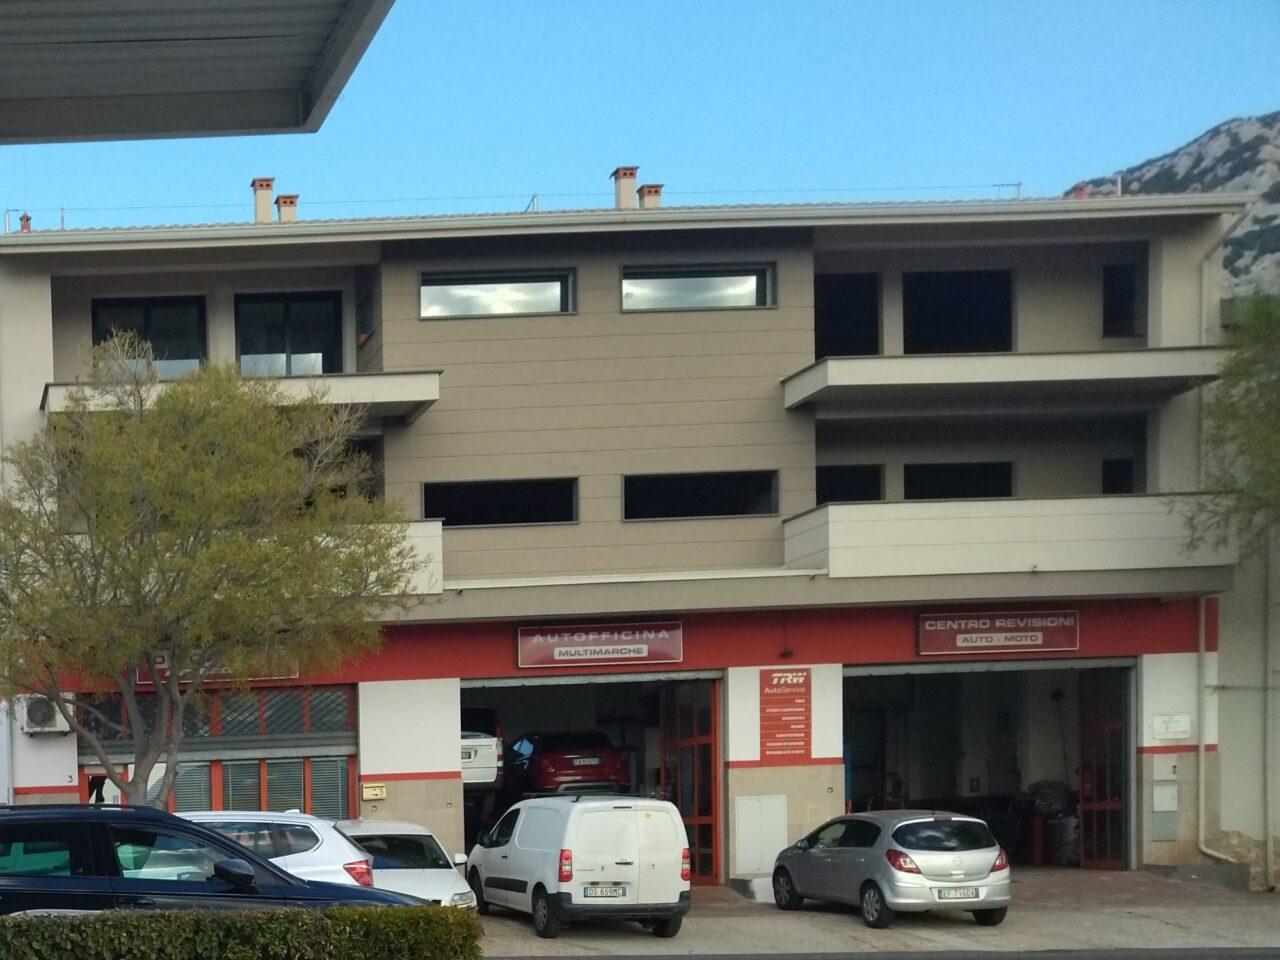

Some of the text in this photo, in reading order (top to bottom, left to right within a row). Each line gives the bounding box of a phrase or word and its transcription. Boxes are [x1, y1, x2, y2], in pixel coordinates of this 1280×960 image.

[924, 616, 1075, 631] CENTRO REVISIONI
[531, 629, 670, 644] AUTOFFICINA
[961, 636, 994, 644] AUTO
[1004, 634, 1039, 643] MOTO
[557, 646, 645, 658] MULTIMARCHE
[771, 672, 807, 685] TRW
[764, 686, 806, 695] AutoService
